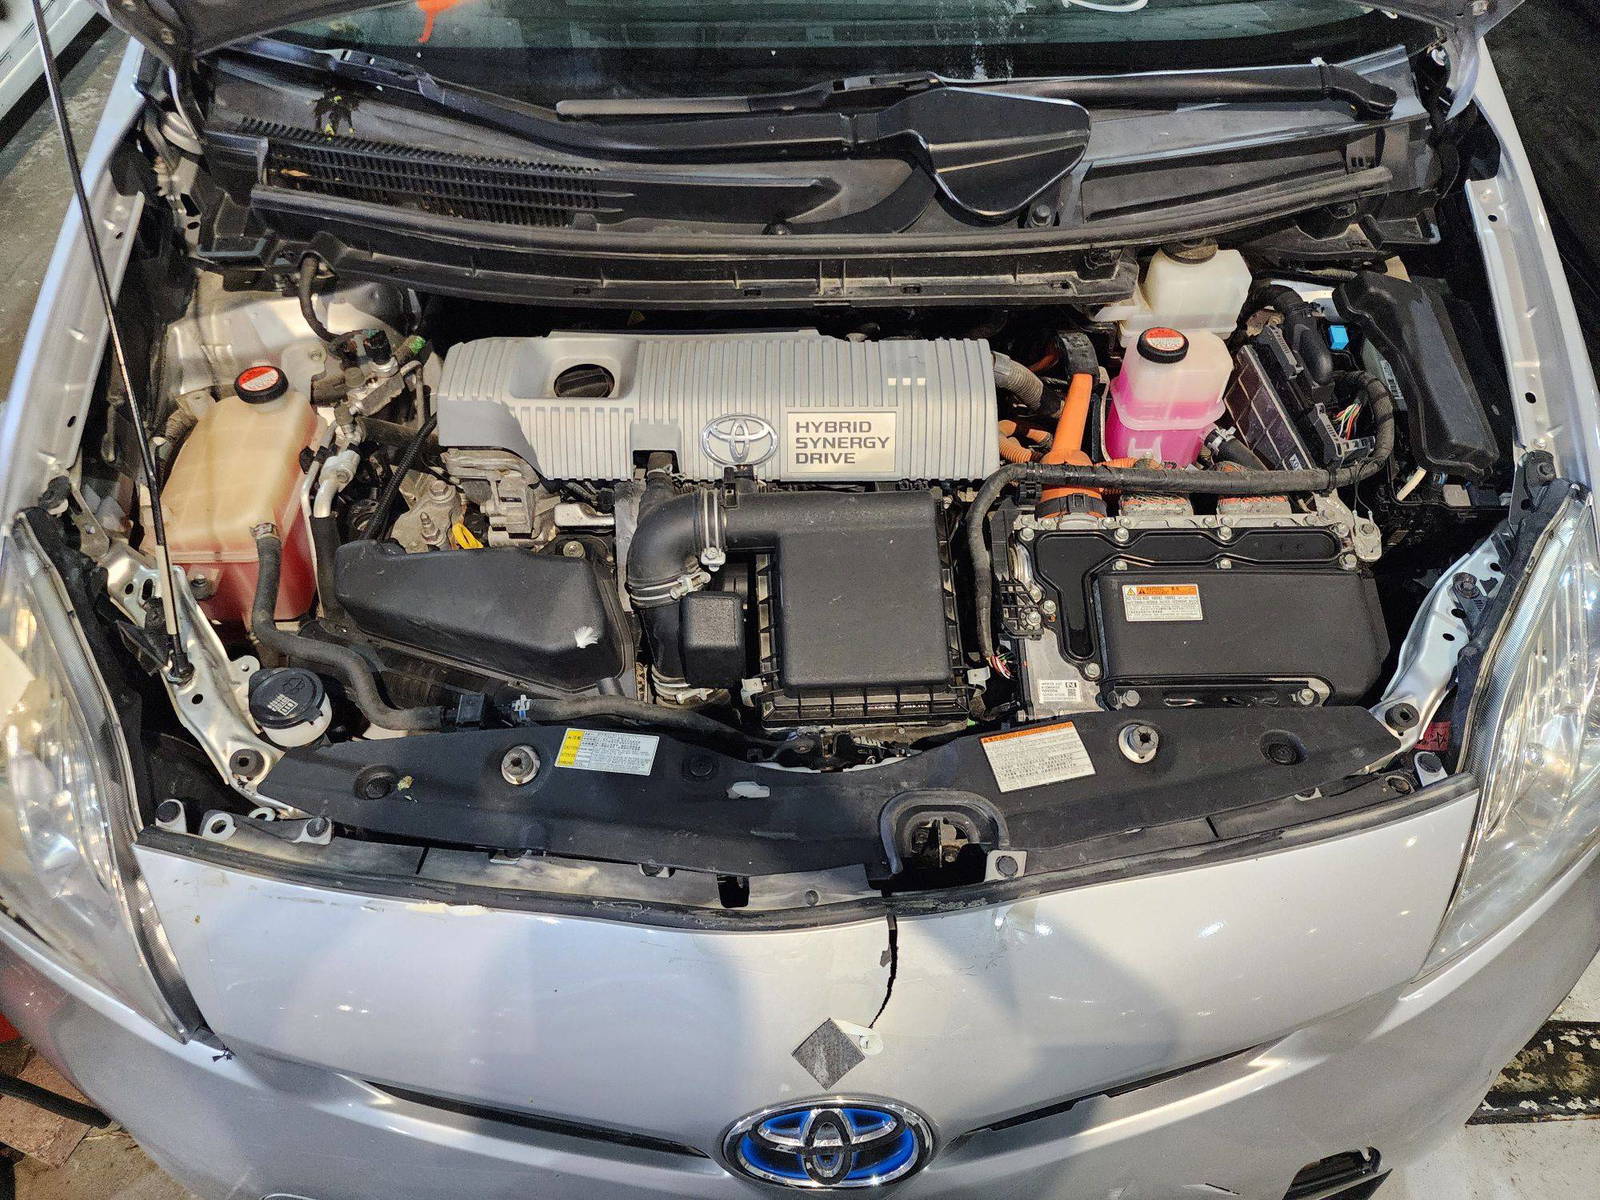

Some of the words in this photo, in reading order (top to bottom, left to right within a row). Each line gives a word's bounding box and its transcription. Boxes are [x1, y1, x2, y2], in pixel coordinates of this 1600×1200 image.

[796, 421, 872, 433] HYBRID
[795, 437, 890, 449] SYNERGY
[795, 452, 856, 464] DRIVE
